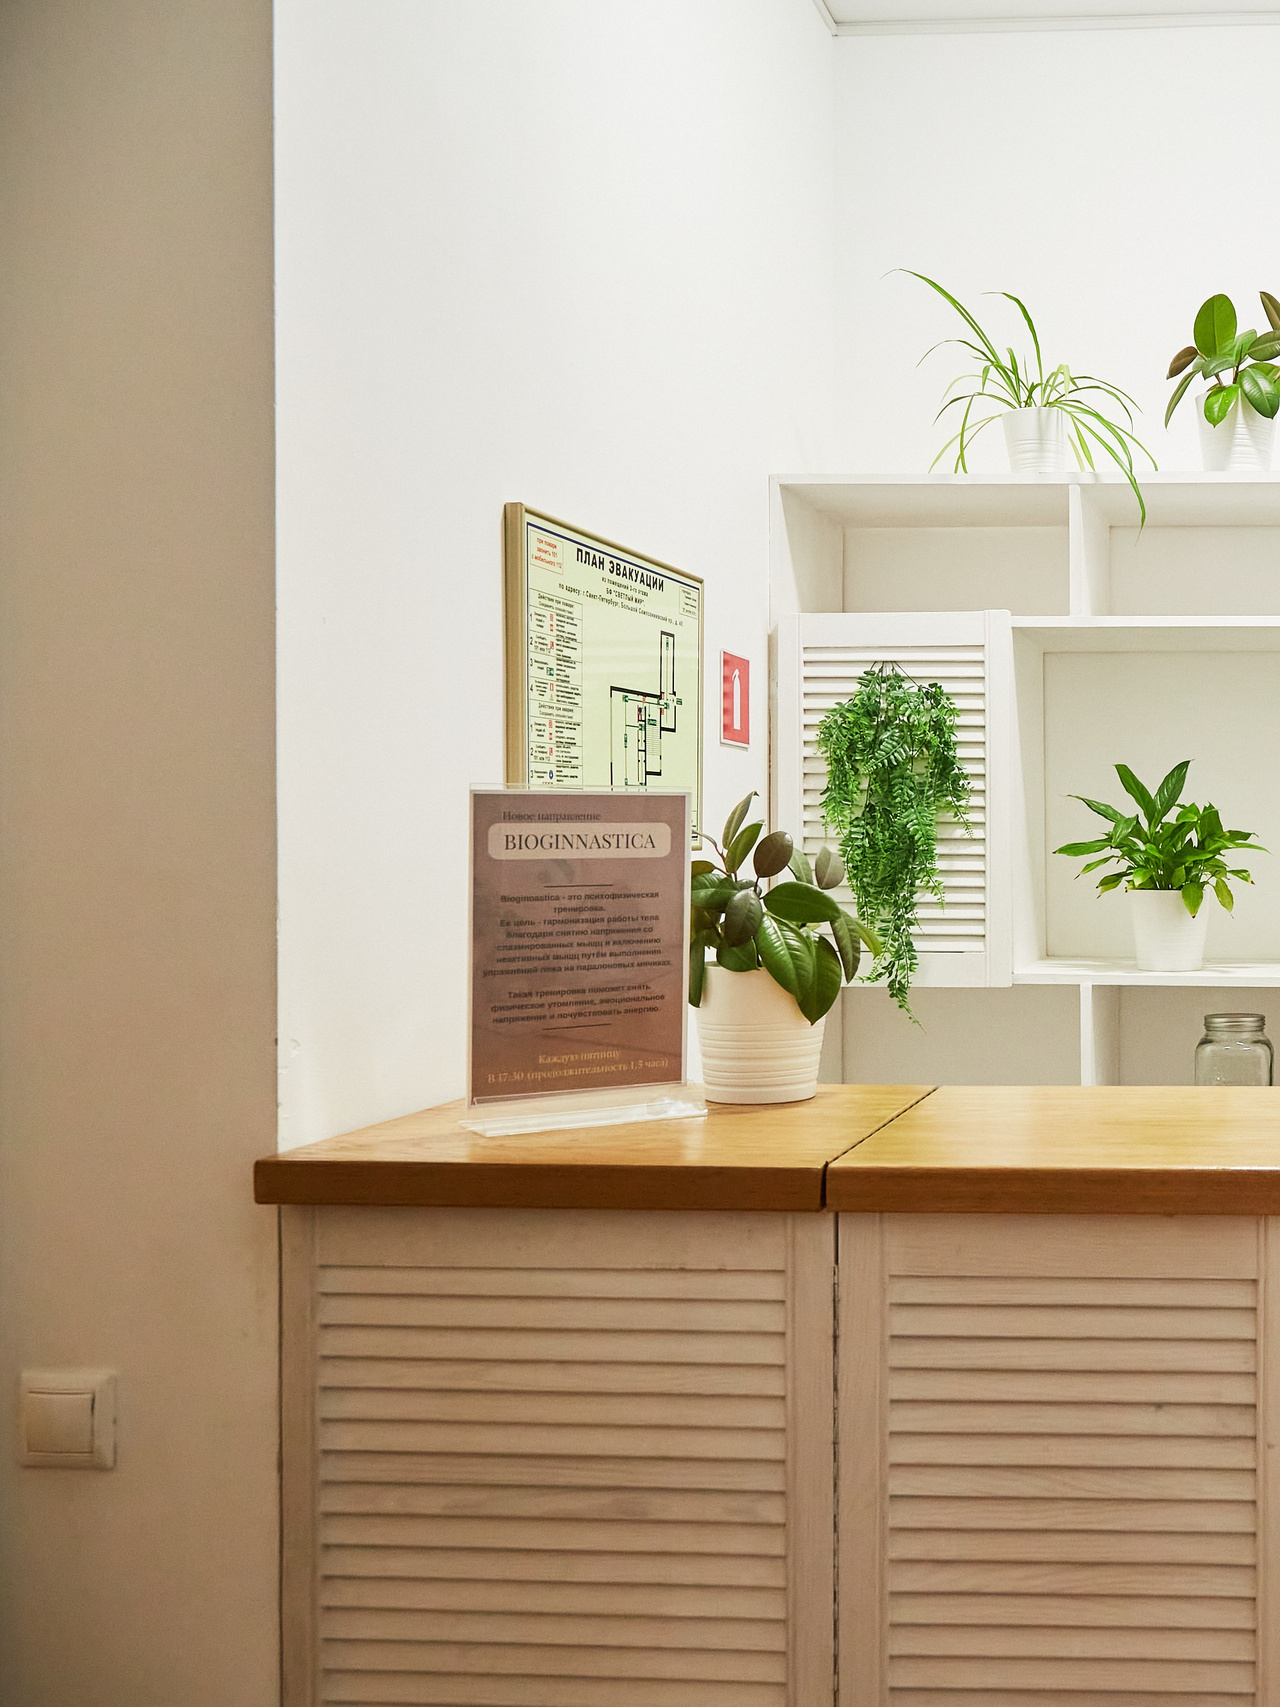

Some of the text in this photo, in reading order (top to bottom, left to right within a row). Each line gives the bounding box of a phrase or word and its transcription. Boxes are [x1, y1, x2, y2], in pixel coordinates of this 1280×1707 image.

[576, 547, 664, 592] ПЛАН ЭВАКУАЦИИ
[502, 810, 601, 823] Новое направление
[504, 833, 656, 851] BIOGINNASTICA
[500, 894, 560, 906] Bioginnastica
[584, 891, 660, 901] психофизическая
[513, 919, 536, 928] цель
[543, 917, 605, 927] гармонизация
[606, 915, 639, 924] работы
[505, 929, 554, 941] благодаря
[555, 928, 589, 937] снятию
[590, 927, 642, 936] напряжения
[576, 940, 603, 950] мышц
[507, 990, 533, 999] Такая
[535, 987, 587, 998] тренировка
[588, 985, 625, 994] поможет
[491, 1002, 545, 1013] физическое
[492, 1013, 547, 1024] напряжение
[538, 1050, 621, 1065] Каждую пятницу
[498, 1072, 523, 1083] 17:30
[527, 1065, 628, 1081] (продолжительность
[645, 1059, 669, 1069] часа)
